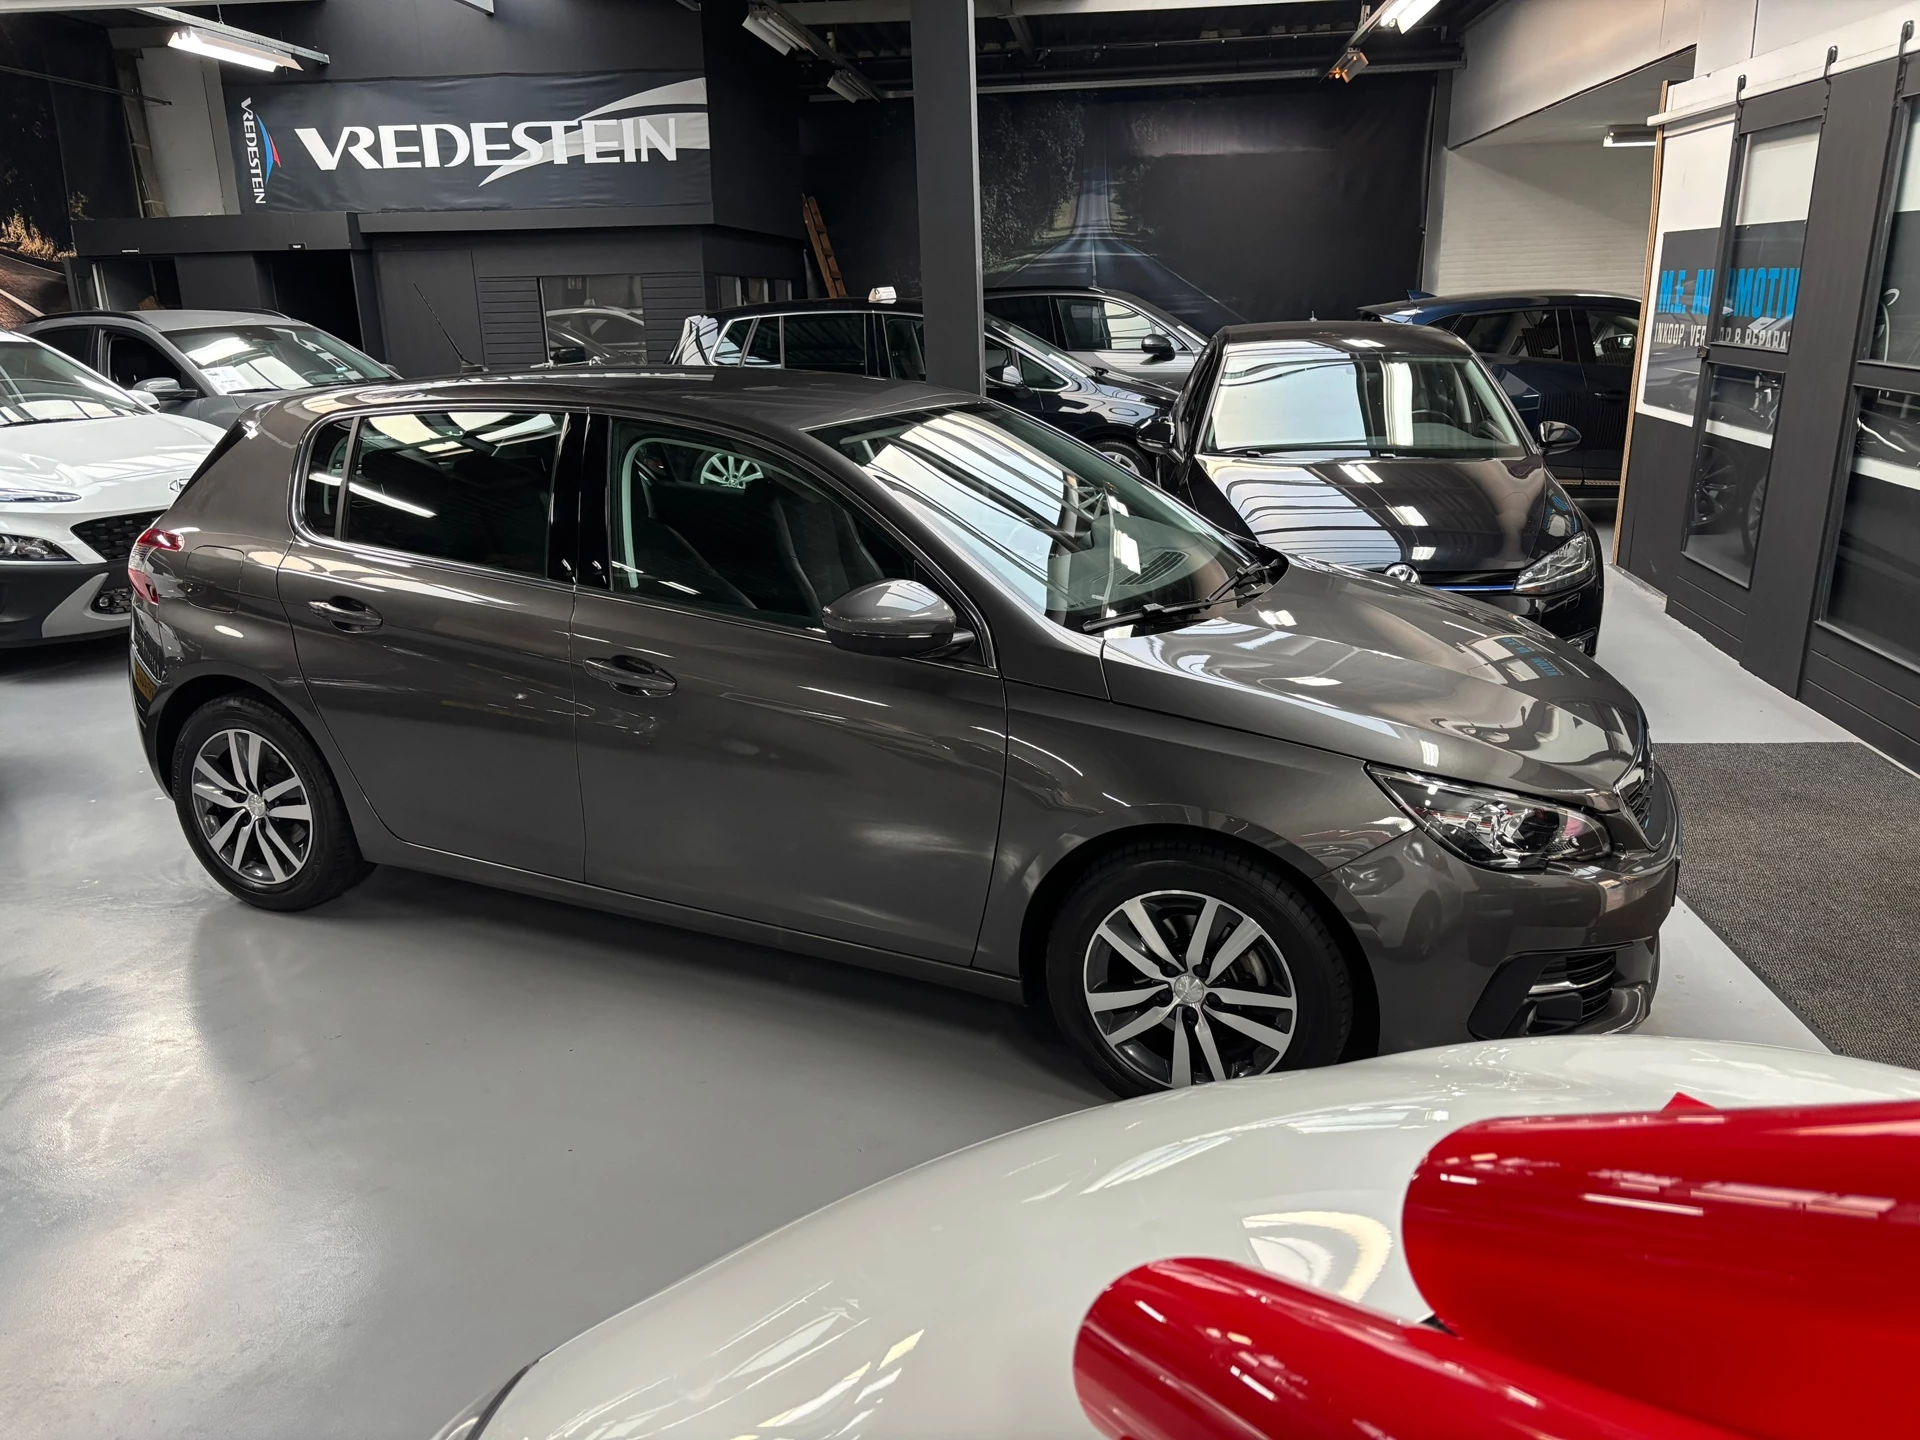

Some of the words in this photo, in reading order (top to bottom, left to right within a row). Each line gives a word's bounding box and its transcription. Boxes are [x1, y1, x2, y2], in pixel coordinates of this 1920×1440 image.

[241, 97, 266, 204] VREDESTEIN
[294, 117, 677, 171] VREDESTEIN
[1657, 269, 1687, 314] M.E.
[1691, 266, 1800, 320] AUOMOTIV
[1654, 322, 1686, 349] INKOOP,
[1734, 327, 1741, 344] &
[1744, 327, 1790, 349] REPARA
